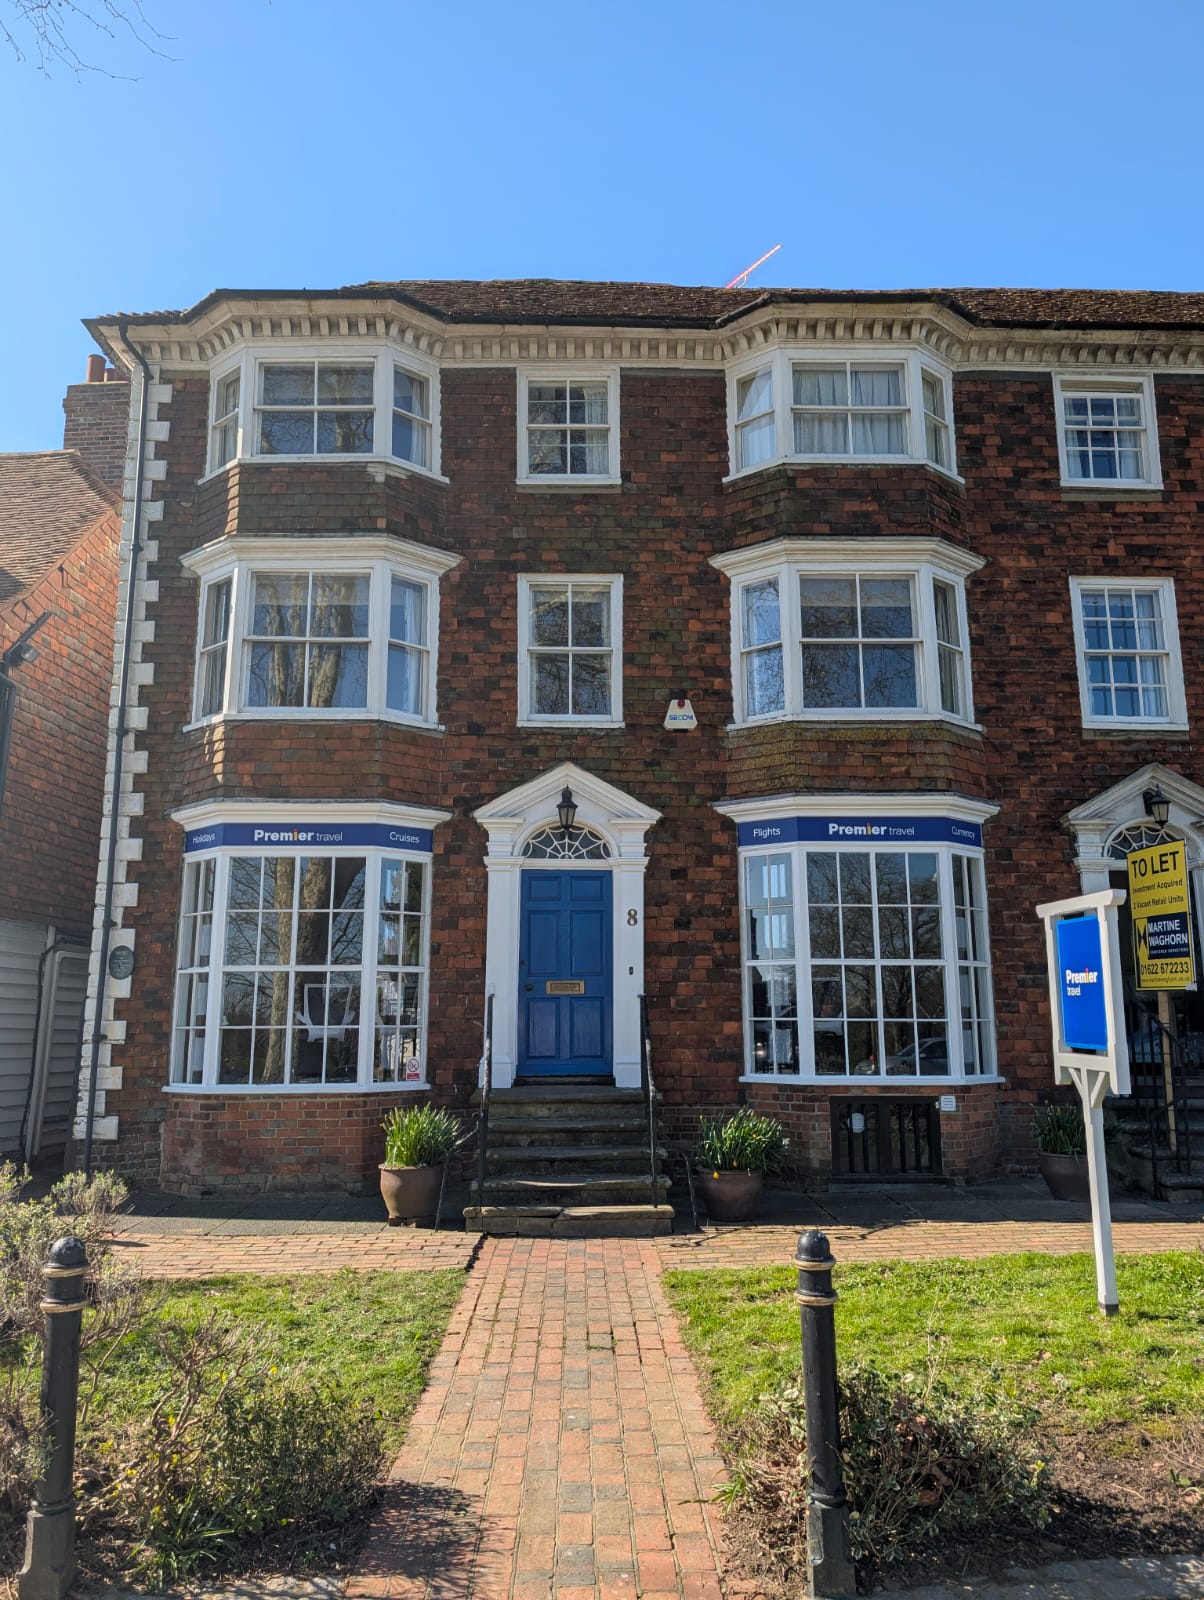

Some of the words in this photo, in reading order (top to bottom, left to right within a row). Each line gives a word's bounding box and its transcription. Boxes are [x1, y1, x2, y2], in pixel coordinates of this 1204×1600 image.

[254, 828, 314, 842] Premier
[316, 832, 343, 842] travel
[753, 826, 781, 839] Flights
[828, 821, 887, 836] Premier
[889, 825, 915, 836] travel
[951, 825, 975, 841] Currency
[193, 832, 216, 845] Holidays
[389, 831, 420, 844] Cruises
[1131, 858, 1147, 879] TO
[1151, 850, 1179, 875] LET
[1157, 878, 1183, 890] Acquired
[1152, 896, 1167, 907] Retail
[1168, 895, 1184, 904] Units
[627, 908, 638, 927] 8
[1148, 919, 1180, 933] MARTINE
[1149, 933, 1188, 946] WAGHORN
[1141, 963, 1159, 976] 01622
[1160, 961, 1189, 975] 672233
[1065, 968, 1098, 985] Premier
[1066, 985, 1081, 996] travel
